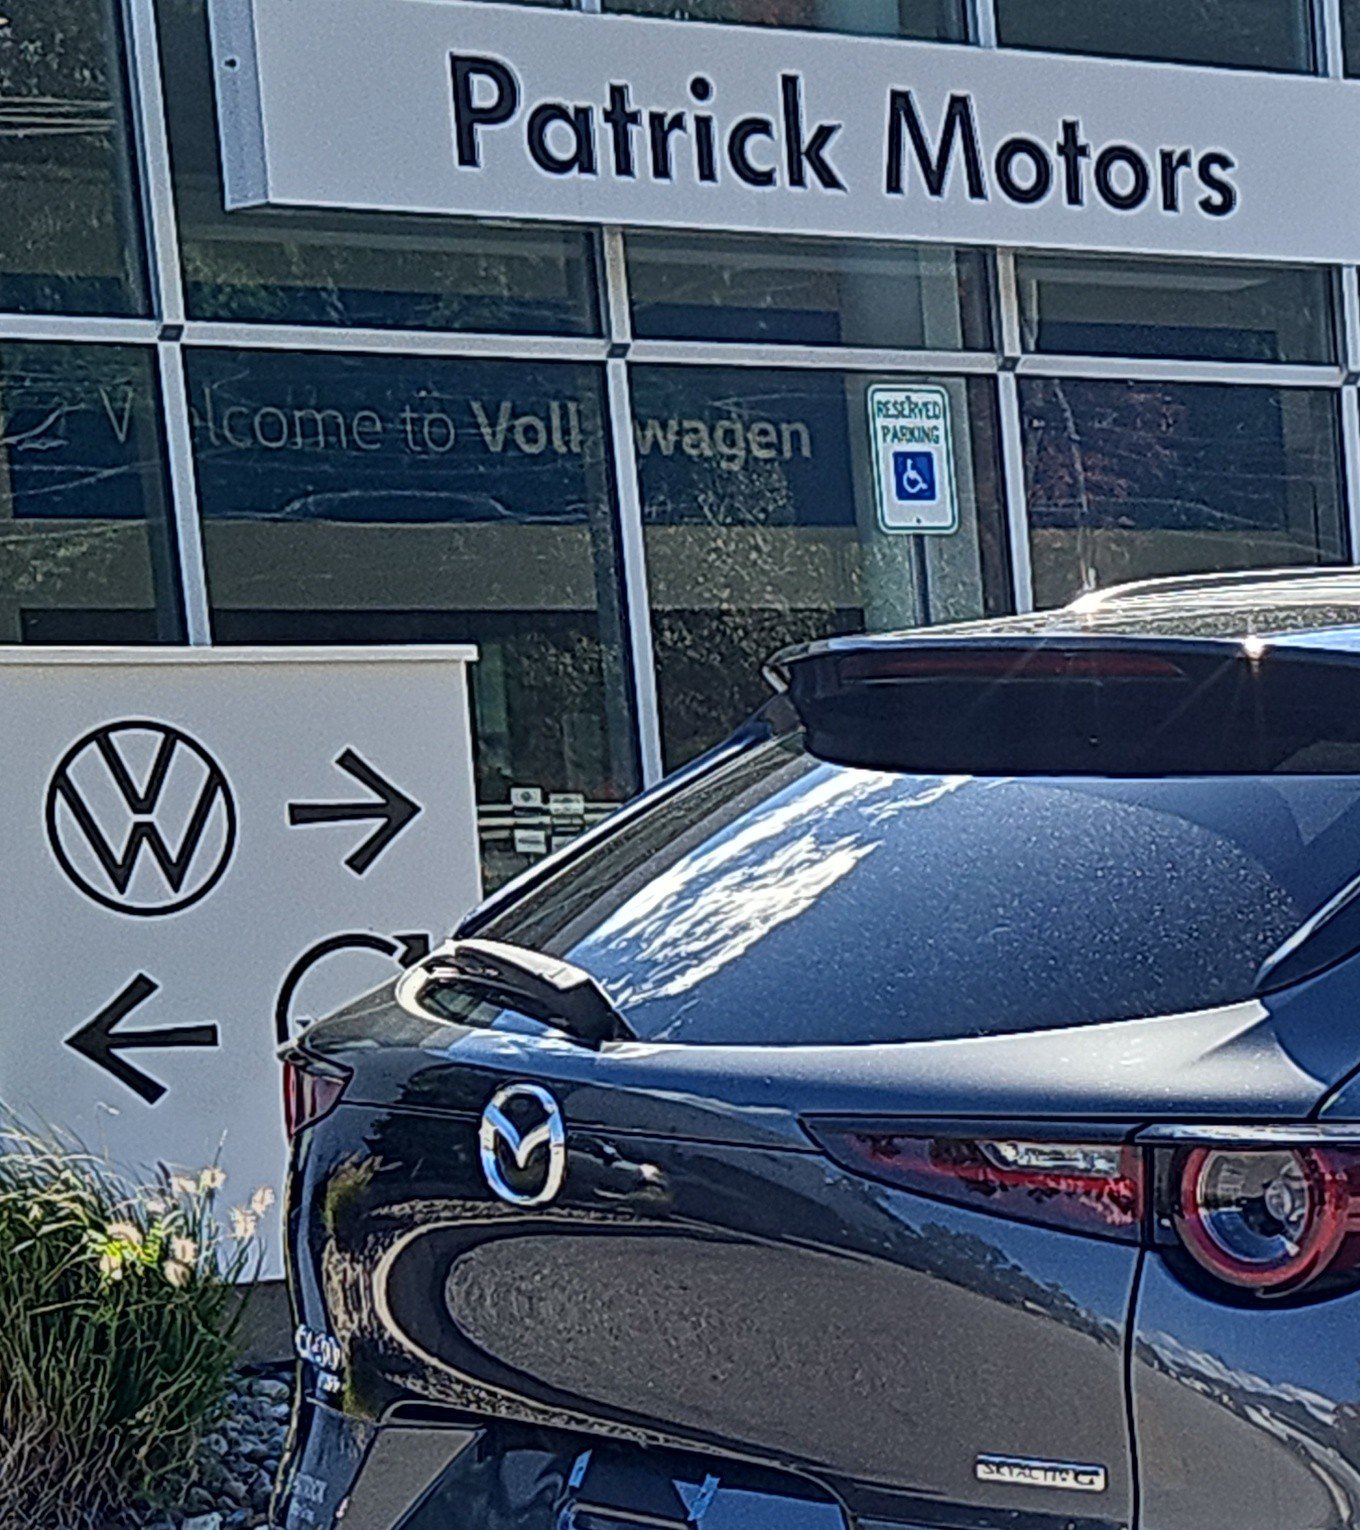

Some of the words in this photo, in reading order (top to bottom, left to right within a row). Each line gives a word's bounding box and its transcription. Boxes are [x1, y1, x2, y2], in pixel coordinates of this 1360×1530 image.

[450, 50, 848, 193] Patrick
[885, 88, 1237, 217] Motors
[99, 386, 384, 452] lcome
[401, 399, 457, 453] to
[471, 400, 813, 470] Volwagen
[876, 399, 941, 420] RESERVED
[881, 425, 940, 444] PARKING
